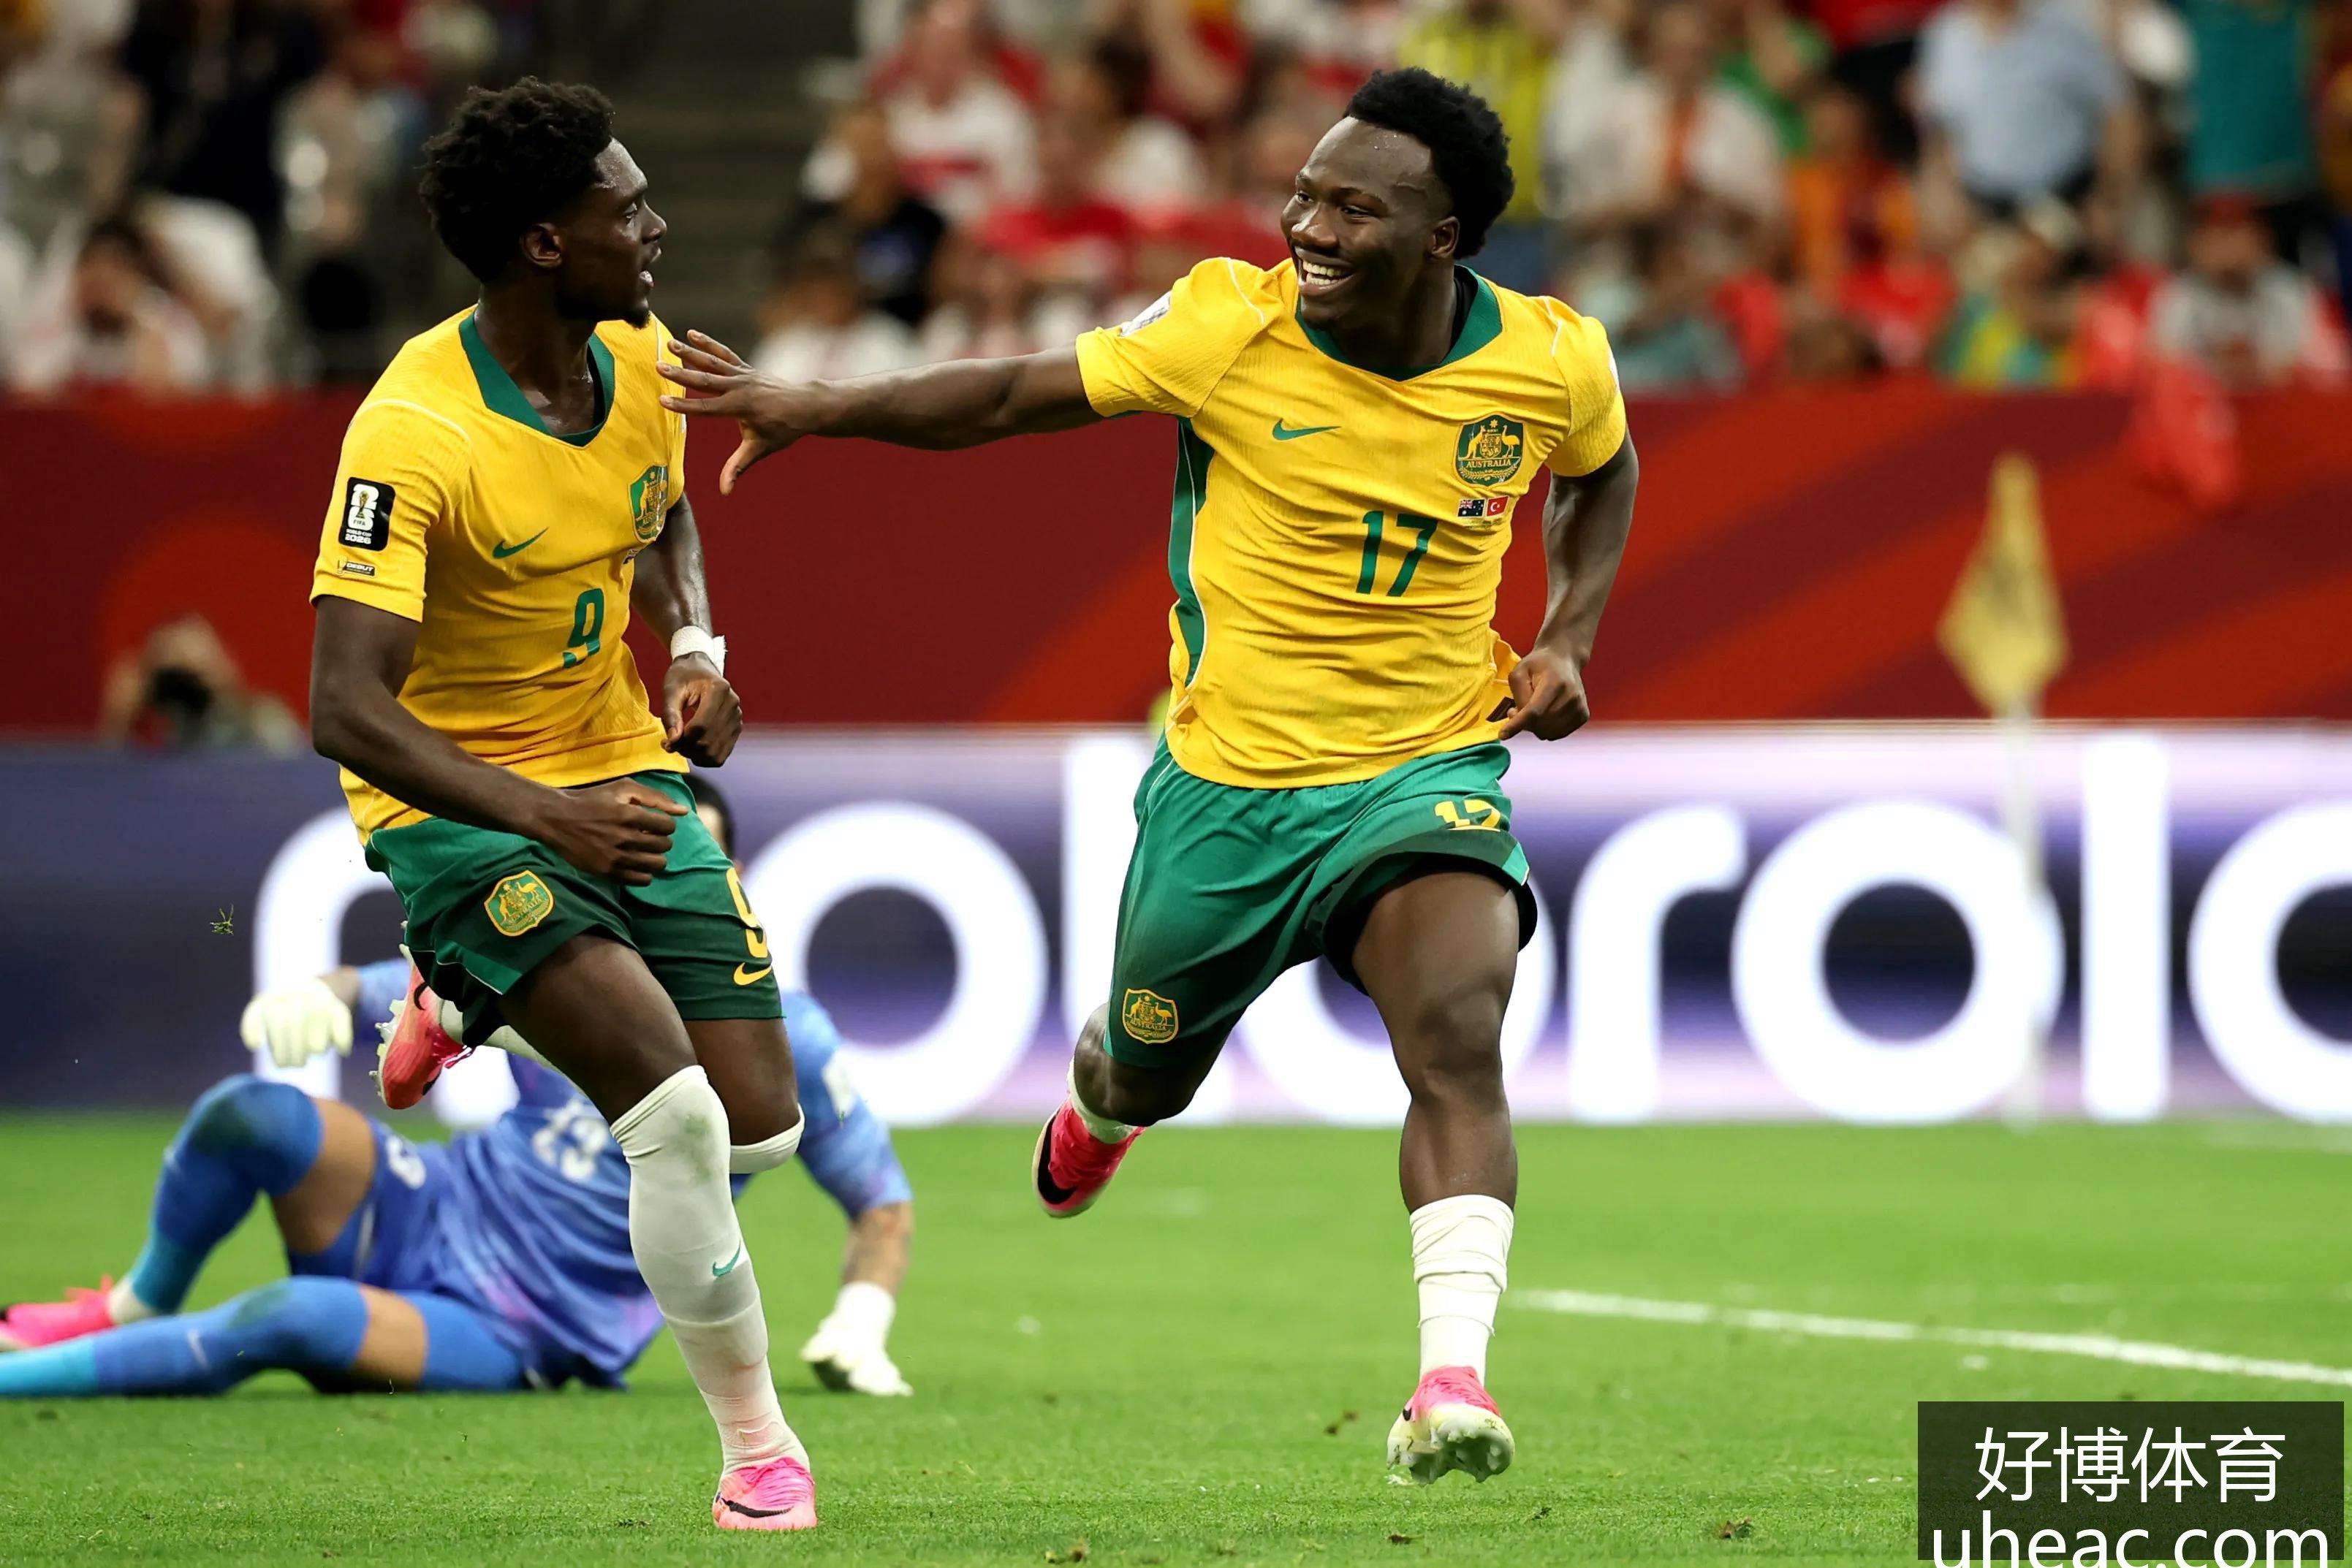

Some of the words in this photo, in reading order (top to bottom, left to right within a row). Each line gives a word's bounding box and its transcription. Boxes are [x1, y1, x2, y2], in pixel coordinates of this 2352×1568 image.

[1466, 460, 1511, 468] AUSTRALIA
[344, 533, 372, 544] 2026
[1355, 510, 1438, 597] 17
[346, 563, 374, 572] DEBUT
[561, 587, 605, 669] 9
